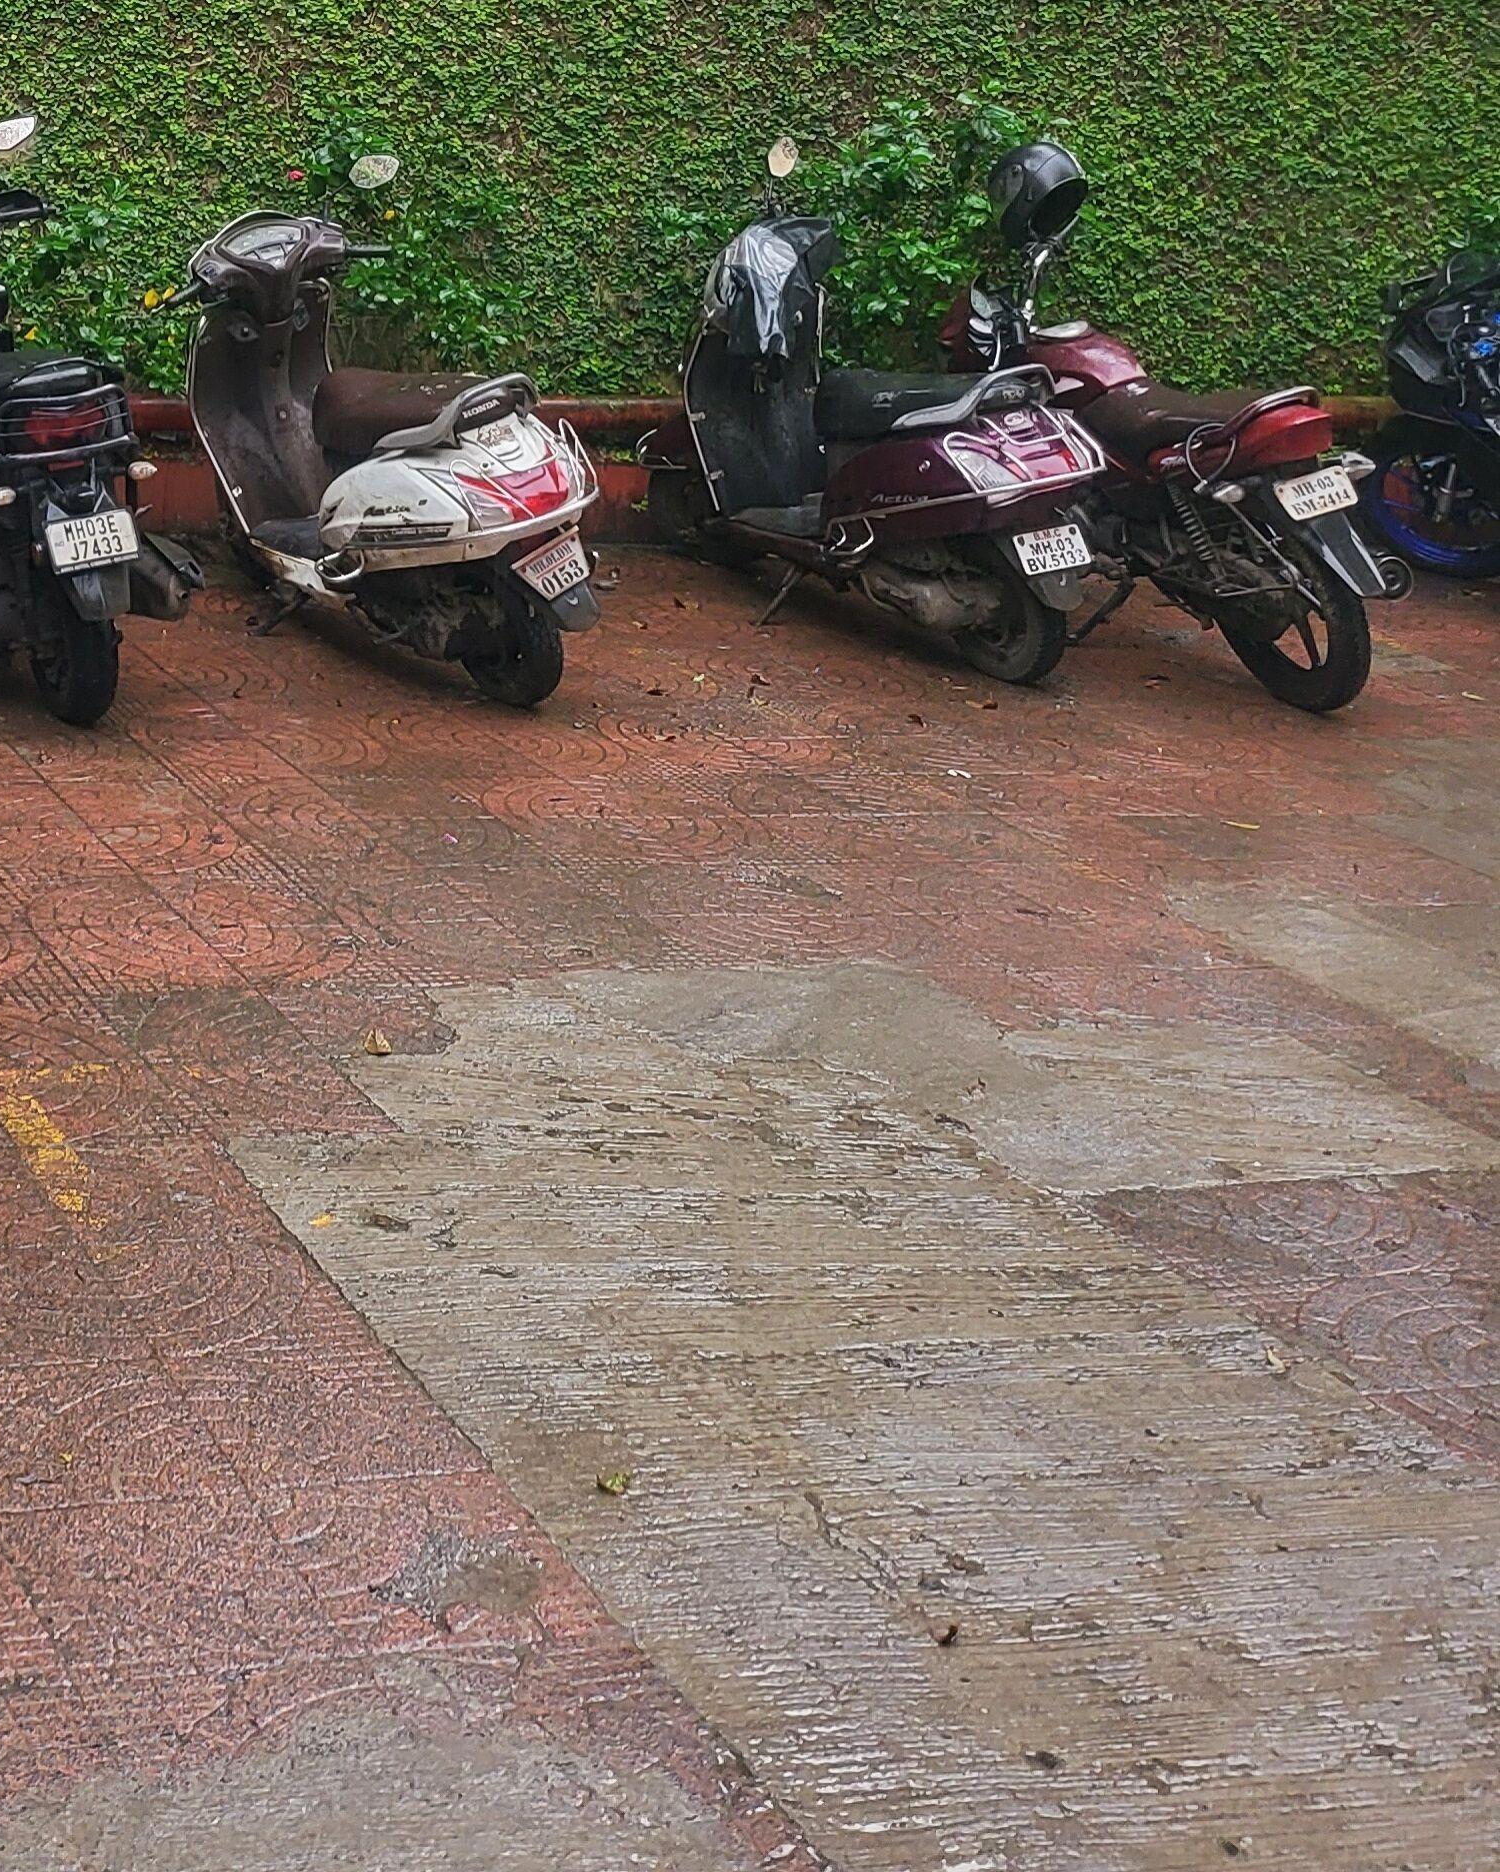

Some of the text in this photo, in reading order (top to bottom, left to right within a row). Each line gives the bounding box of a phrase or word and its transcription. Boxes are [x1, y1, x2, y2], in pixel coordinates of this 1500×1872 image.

[462, 398, 501, 419] HONDA
[64, 514, 120, 542] MH03E
[70, 534, 124, 562] J7433
[540, 558, 585, 596] 0153
